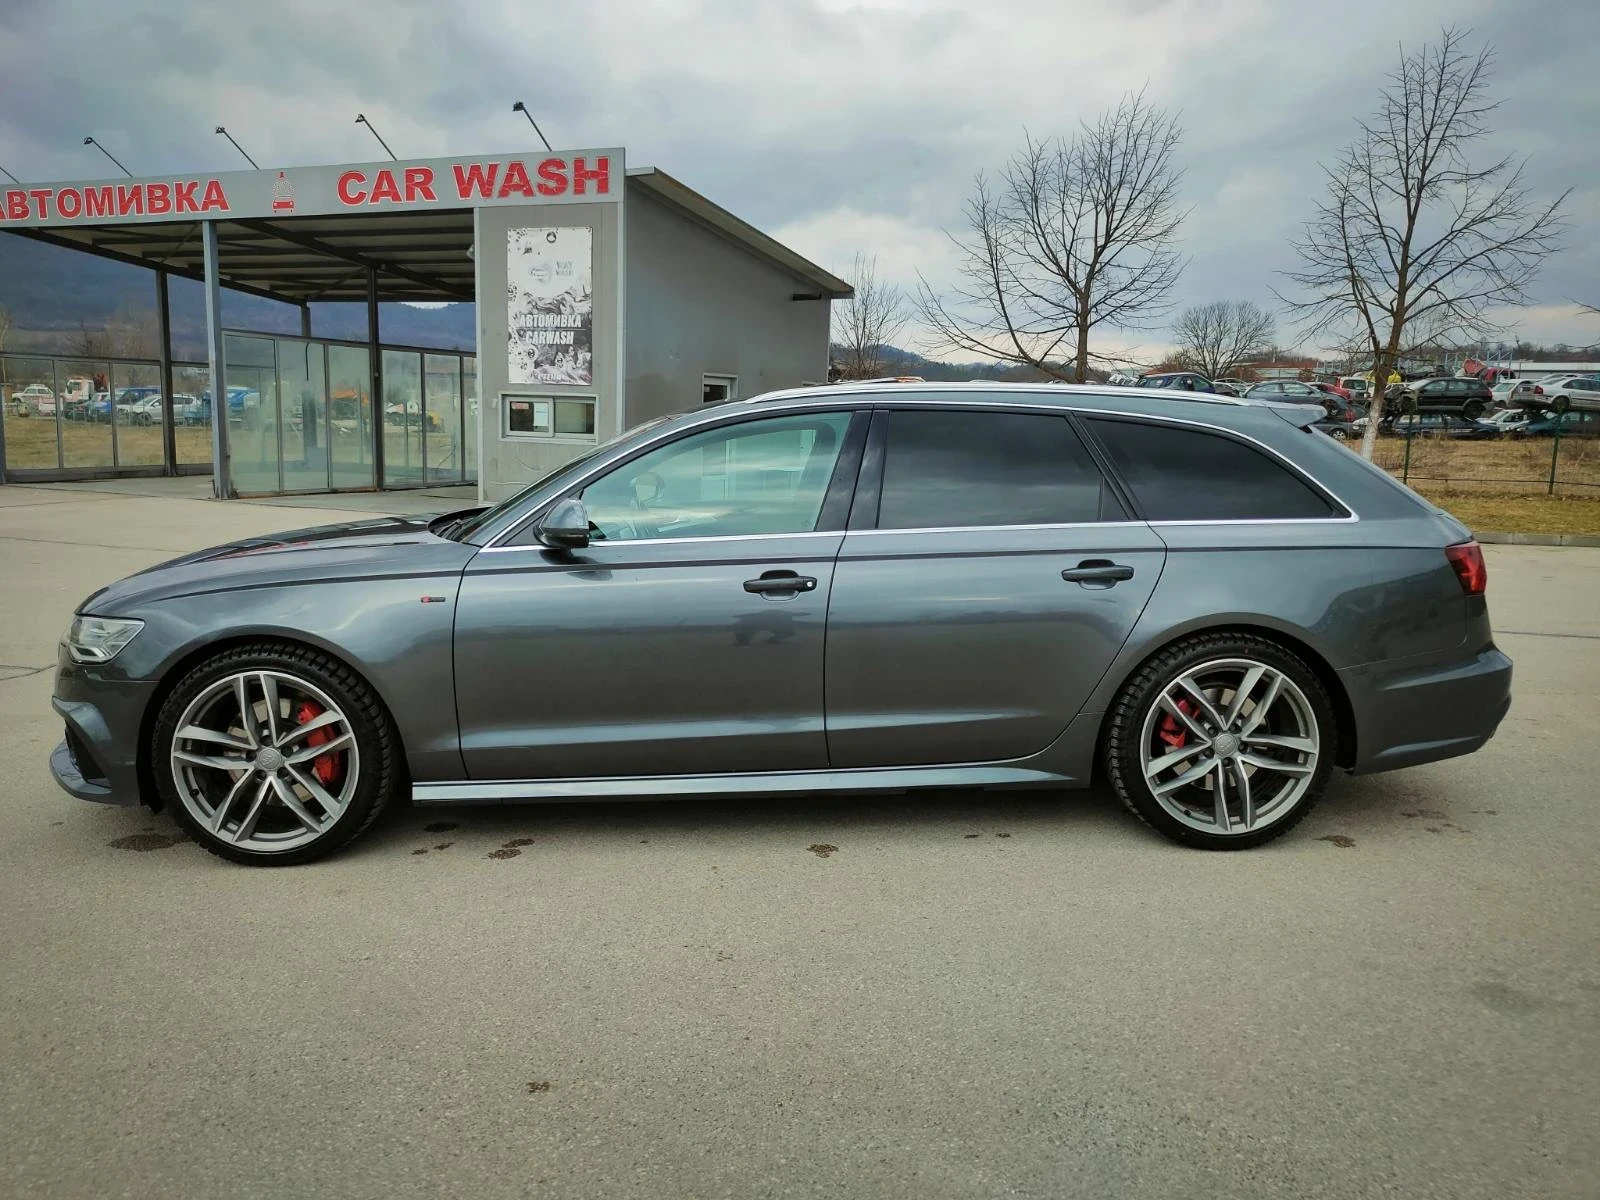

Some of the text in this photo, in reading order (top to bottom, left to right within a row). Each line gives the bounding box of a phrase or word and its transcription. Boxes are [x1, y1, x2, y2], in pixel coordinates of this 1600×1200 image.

[337, 156, 610, 205] CAR WASH
[519, 314, 582, 328] АВТОМИВКА
[525, 331, 575, 345] CARWASH
